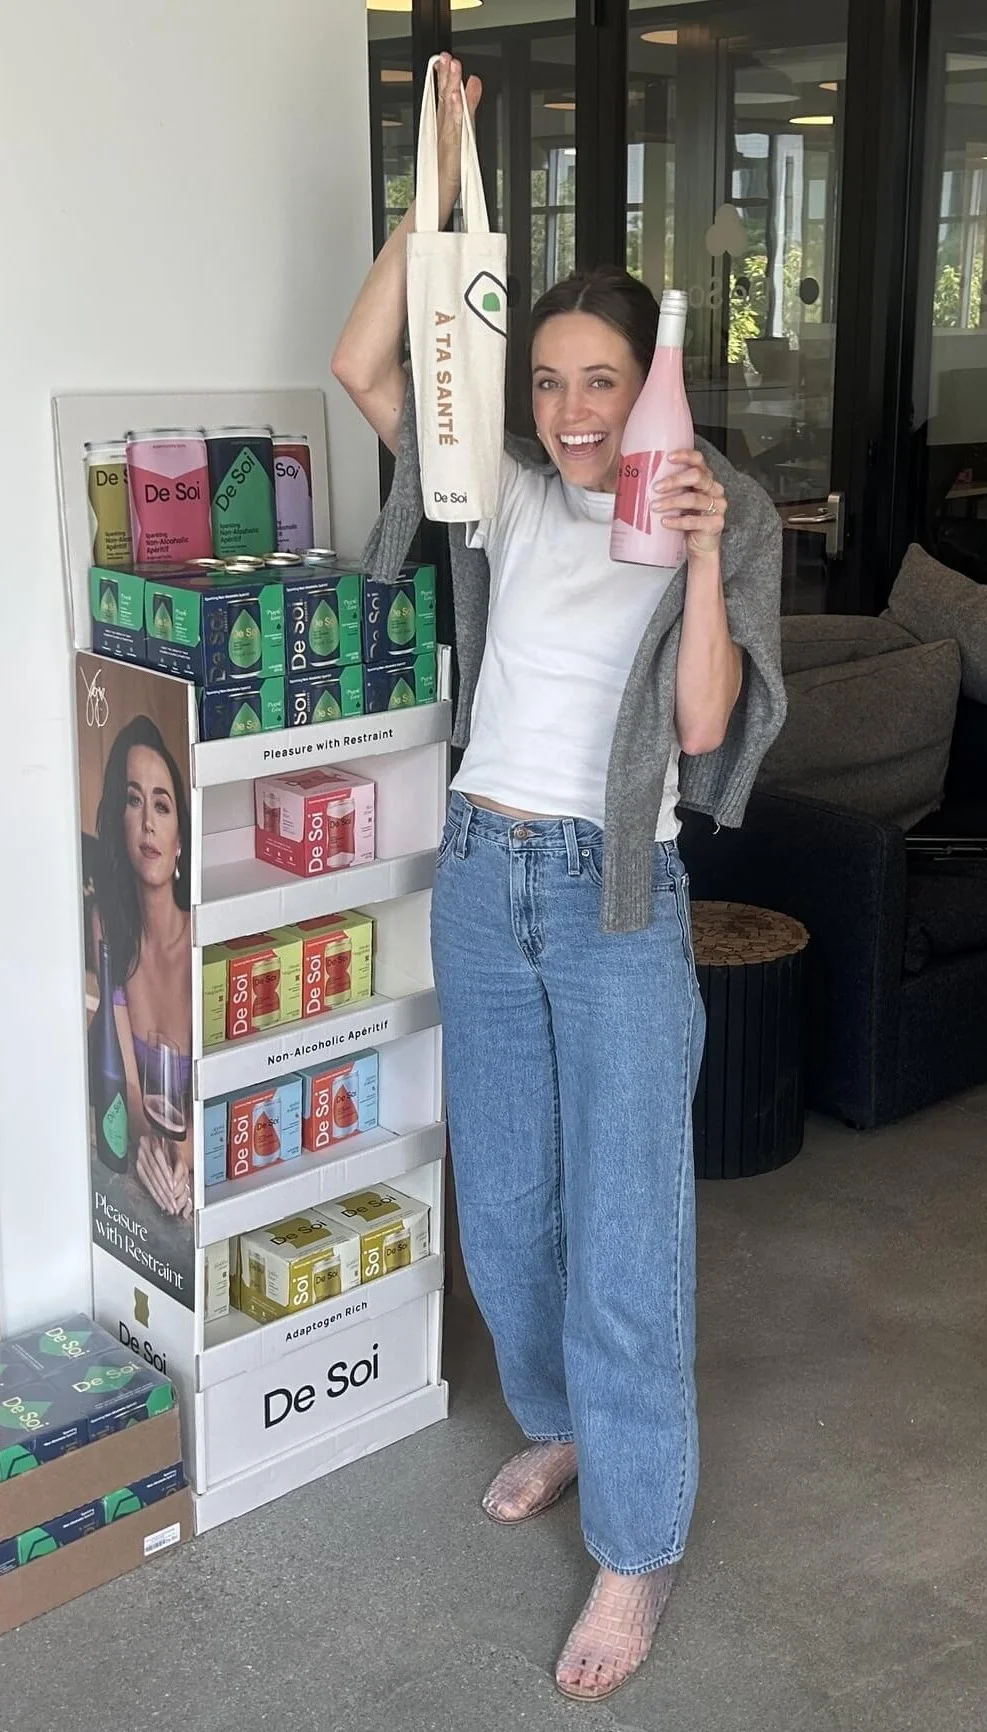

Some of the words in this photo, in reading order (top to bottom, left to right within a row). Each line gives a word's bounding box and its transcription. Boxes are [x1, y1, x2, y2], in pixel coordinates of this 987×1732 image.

[435, 310, 456, 326] À
[436, 333, 452, 362] TA
[436, 370, 459, 446] SANTÉ
[96, 470, 118, 486] De
[215, 485, 237, 512] De
[231, 451, 256, 484] Soi
[276, 462, 300, 479] Soi
[144, 484, 170, 503] De
[176, 480, 200, 501] Soi
[434, 492, 448, 503] De
[450, 491, 468, 503] Soi
[292, 640, 307, 671] De
[293, 690, 308, 726] Soi
[263, 744, 313, 760] Pleasure
[316, 738, 340, 750] with
[343, 729, 394, 746] Restraint
[308, 812, 323, 842] Soi
[308, 846, 323, 873] De
[306, 954, 320, 984] Soi
[232, 974, 248, 1004] Soi
[306, 987, 320, 1014] De
[233, 1007, 248, 1036] De
[267, 1034, 346, 1066] Non-Alcoholic
[348, 1020, 389, 1041] Apéritif
[314, 1088, 330, 1118] Soi
[234, 1114, 248, 1145] Soi
[316, 1120, 330, 1148] De
[234, 1148, 248, 1176] De
[95, 1192, 148, 1242] Pleasure
[341, 1206, 368, 1218] De
[368, 1194, 397, 1208] Soi
[270, 1233, 298, 1246] De
[298, 1220, 328, 1234] Soi
[96, 1218, 123, 1250] with
[125, 1234, 184, 1290] Restraint
[364, 1247, 380, 1277] Soi
[292, 1274, 308, 1306] Soi
[285, 1312, 342, 1342] Adaptogen
[345, 1301, 368, 1318] Rich
[45, 1327, 67, 1343] De
[62, 1340, 90, 1358] Soi
[118, 1321, 140, 1355] De
[144, 1341, 167, 1376] Soi
[72, 1377, 104, 1393] De
[106, 1361, 140, 1380] Soi
[264, 1384, 316, 1430] De
[326, 1342, 380, 1398] Soi
[2, 1396, 25, 1414] De
[19, 1412, 50, 1430] Soi
